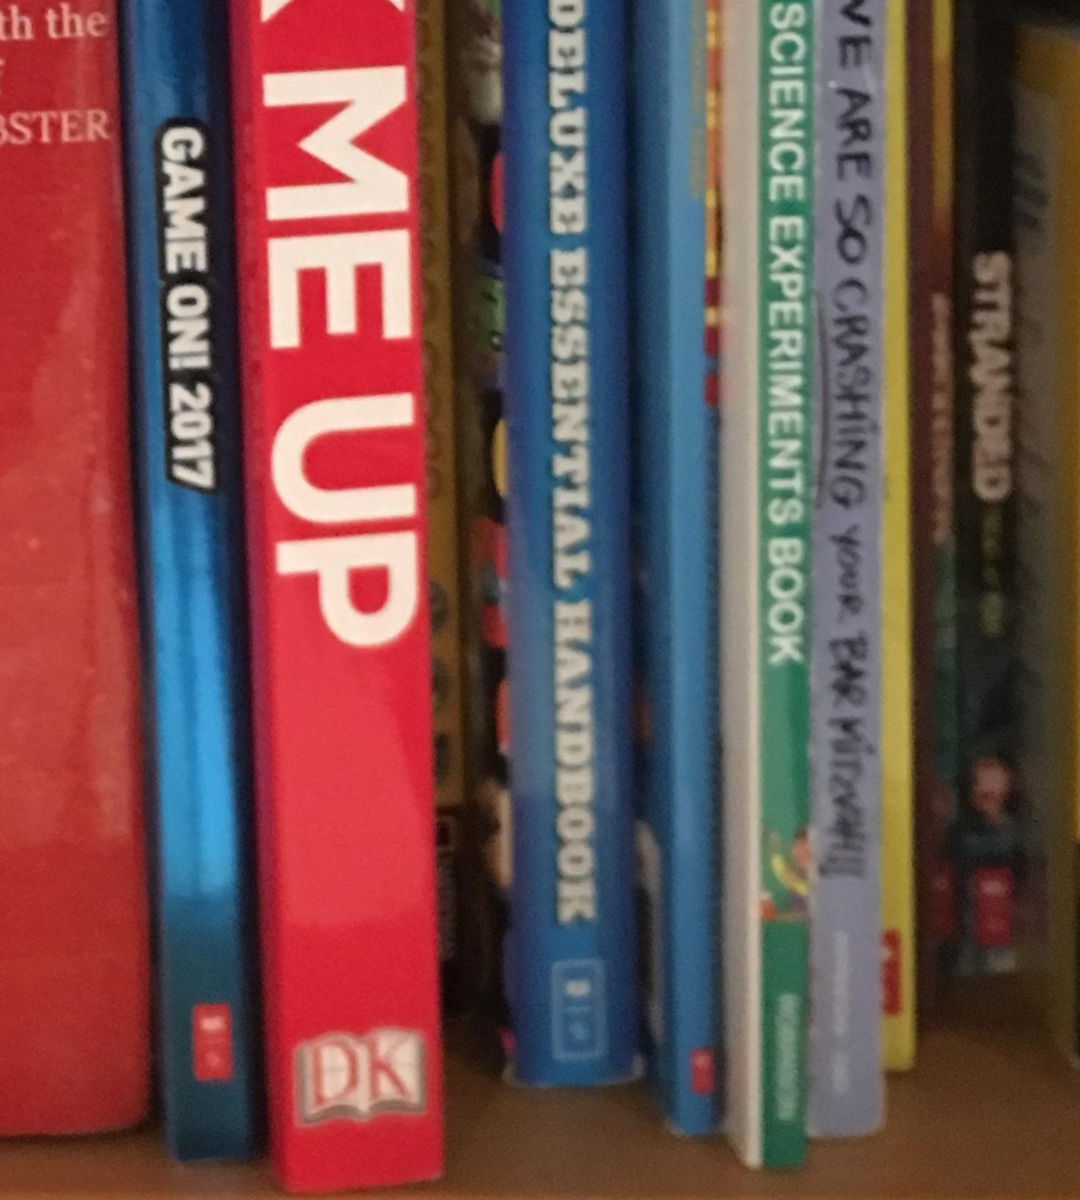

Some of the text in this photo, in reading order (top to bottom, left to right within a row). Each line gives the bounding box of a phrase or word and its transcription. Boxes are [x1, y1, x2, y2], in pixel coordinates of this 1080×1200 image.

[45, 4, 109, 40] the
[768, 3, 806, 201] SCIENCE
[837, 89, 873, 180] ARE
[160, 126, 215, 491] GAME ON! 2017
[263, 65, 414, 349] ME
[835, 195, 873, 266] SO
[549, 247, 593, 590] ESSENTIAL
[767, 214, 805, 527] EXPERIMENTS
[270, 392, 419, 647] UP
[767, 537, 805, 666] BOOK
[553, 599, 598, 926] HANDBOOK
[308, 1031, 422, 1108] DK
